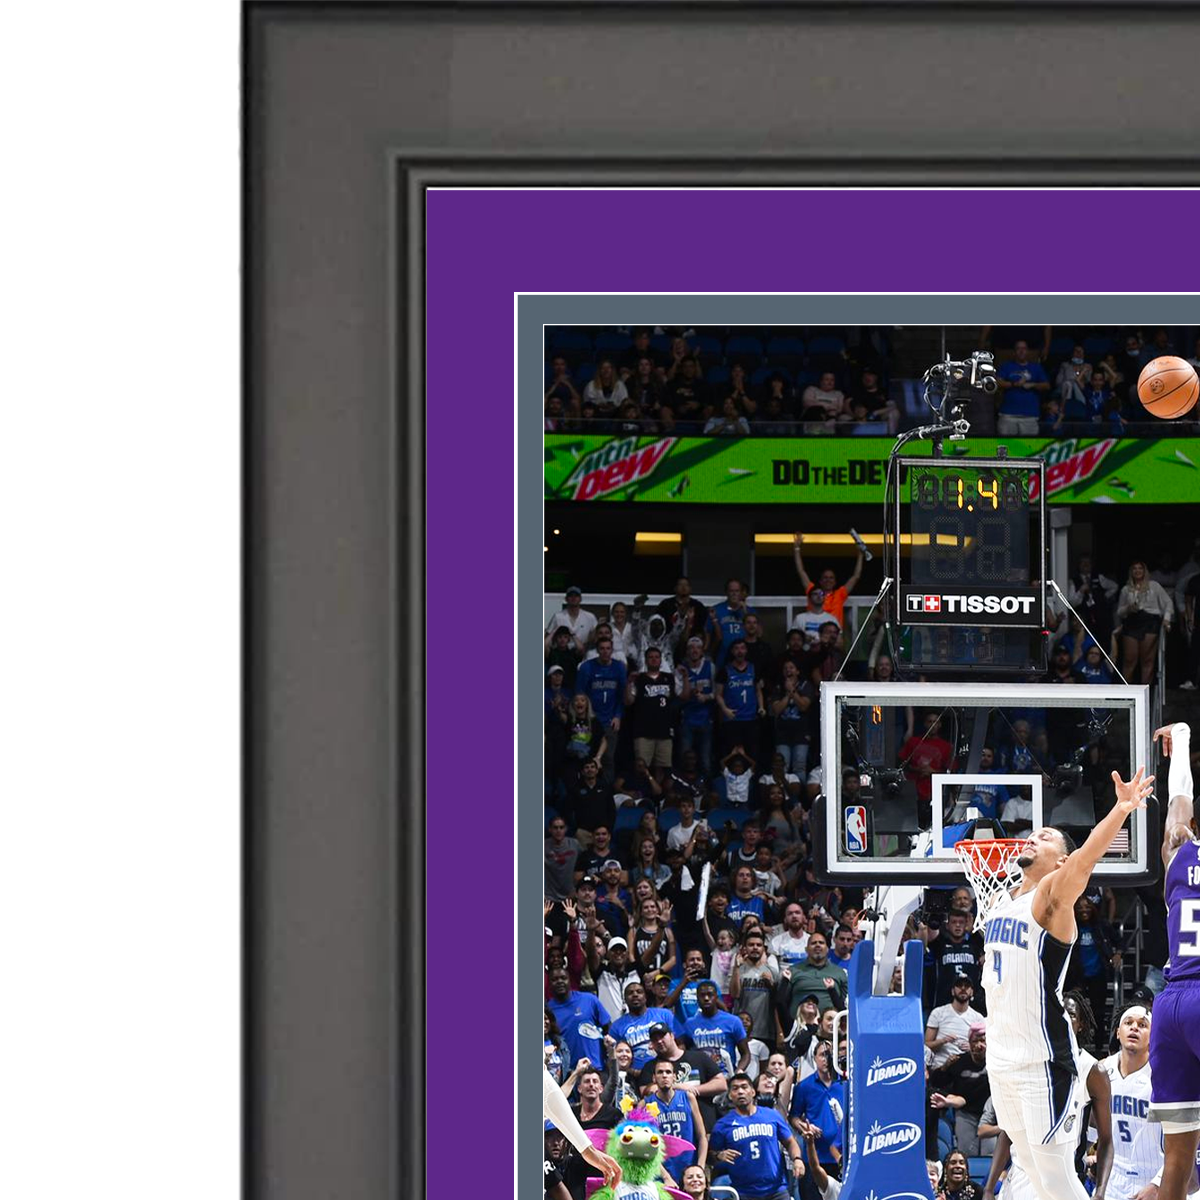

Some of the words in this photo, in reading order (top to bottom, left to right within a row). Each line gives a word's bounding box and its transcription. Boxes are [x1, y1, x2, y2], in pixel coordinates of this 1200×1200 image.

[942, 595, 1036, 614] TISSOT
[993, 950, 1003, 984] 4
[867, 1062, 912, 1086] LIBMAN
[1110, 1095, 1149, 1119] AGIC
[663, 1122, 682, 1138] 22
[732, 1123, 773, 1141] ORLANDO
[1117, 1120, 1132, 1142] 5
[749, 1140, 760, 1160] 5
[862, 1128, 914, 1156] LIBMAN
